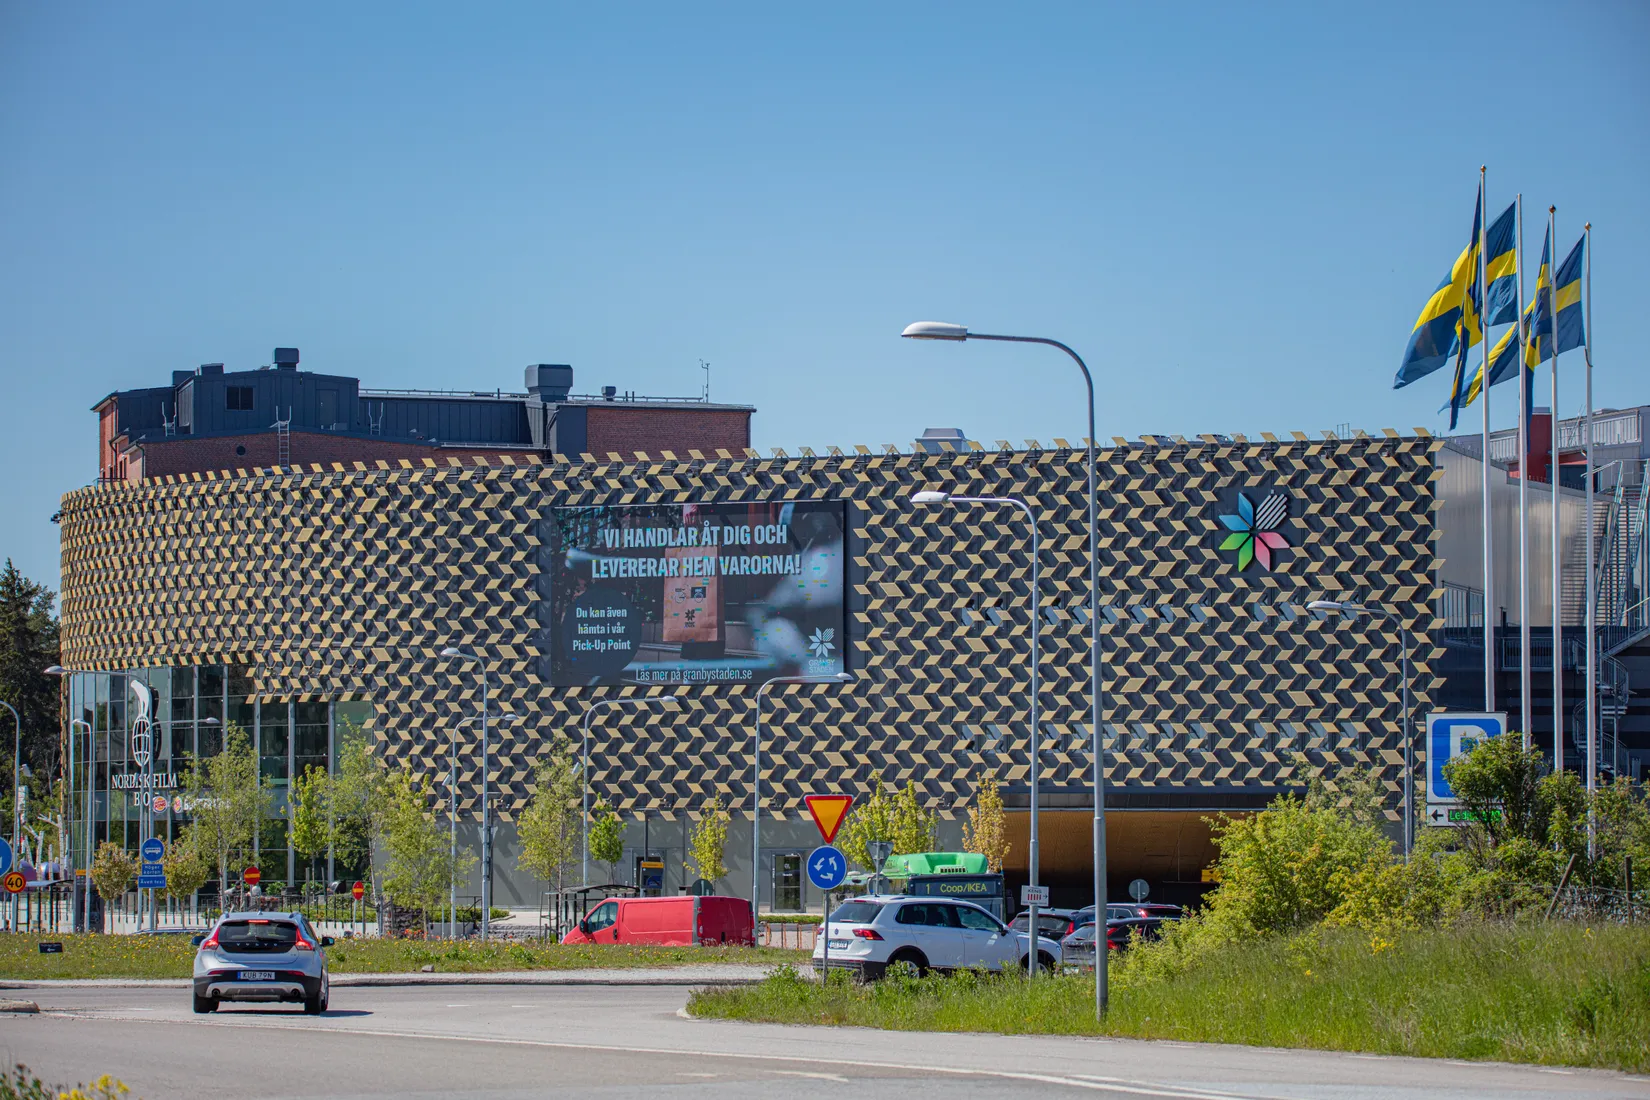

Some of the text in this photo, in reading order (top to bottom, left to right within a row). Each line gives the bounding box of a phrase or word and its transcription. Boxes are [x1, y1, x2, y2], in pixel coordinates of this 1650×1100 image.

[604, 520, 787, 548] VI HANDLAR ÅT DIG OCH
[592, 554, 801, 578] LEVERERAR HEM VARORNA!
[576, 606, 627, 618] Du kan även
[578, 621, 626, 634] hämta i vår
[572, 639, 631, 652] Pick-Up Point
[635, 666, 753, 684] Läs mer på granbystaden.se
[152, 773, 178, 788] FILM
[134, 791, 150, 807] BO
[7, 877, 23, 888] 40
[925, 882, 987, 894] 1 Coop/IKEA
